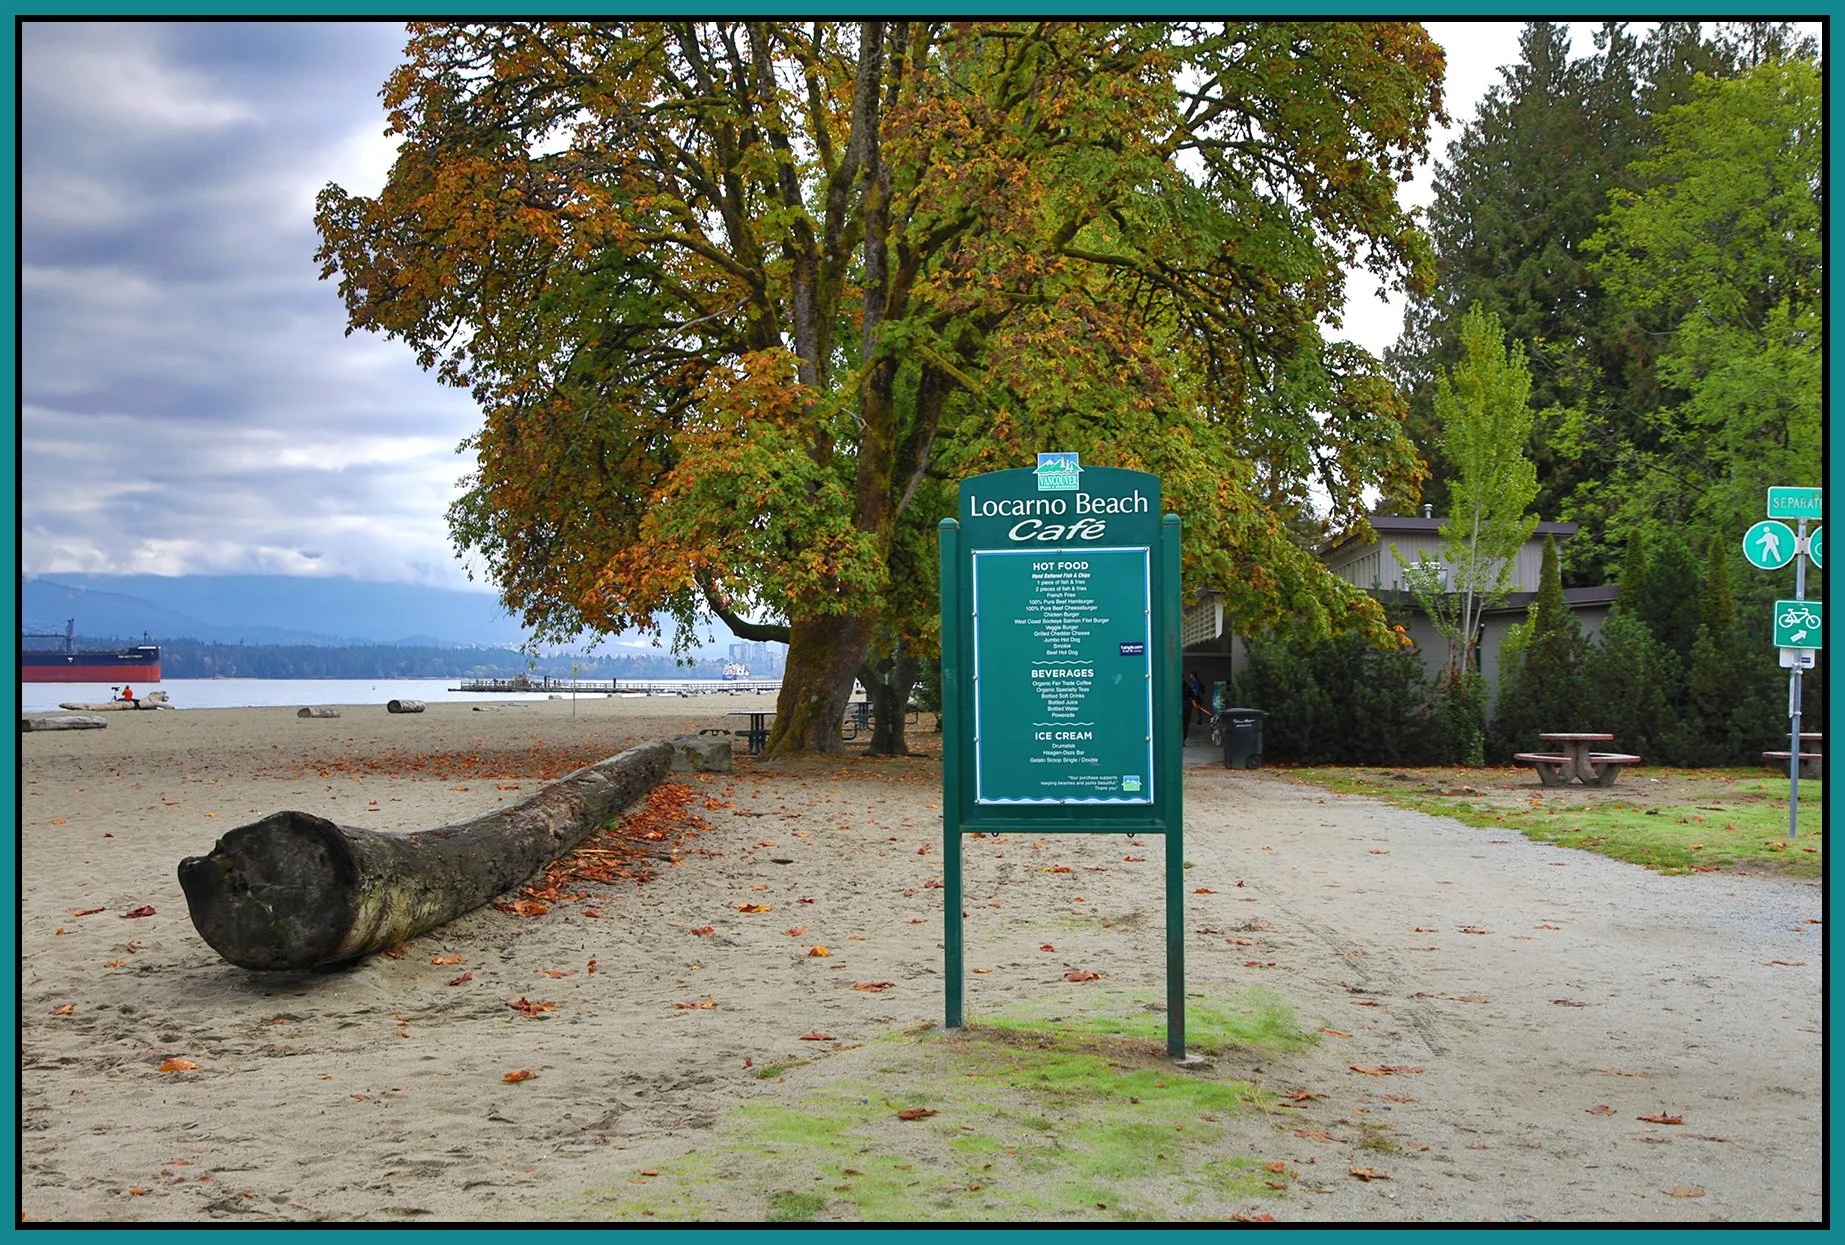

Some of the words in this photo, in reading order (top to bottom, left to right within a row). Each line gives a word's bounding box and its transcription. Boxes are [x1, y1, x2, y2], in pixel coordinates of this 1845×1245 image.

[1040, 476, 1077, 486] VANCOUVER
[971, 496, 1066, 517] Locarno
[1076, 490, 1148, 515] Beach
[1008, 518, 1106, 541] Café
[1033, 562, 1055, 570] HOT
[1058, 562, 1088, 570] FOOD
[1031, 669, 1094, 678] BEVERAGES
[1035, 732, 1052, 740] ICE
[1055, 731, 1093, 740] CREAM
